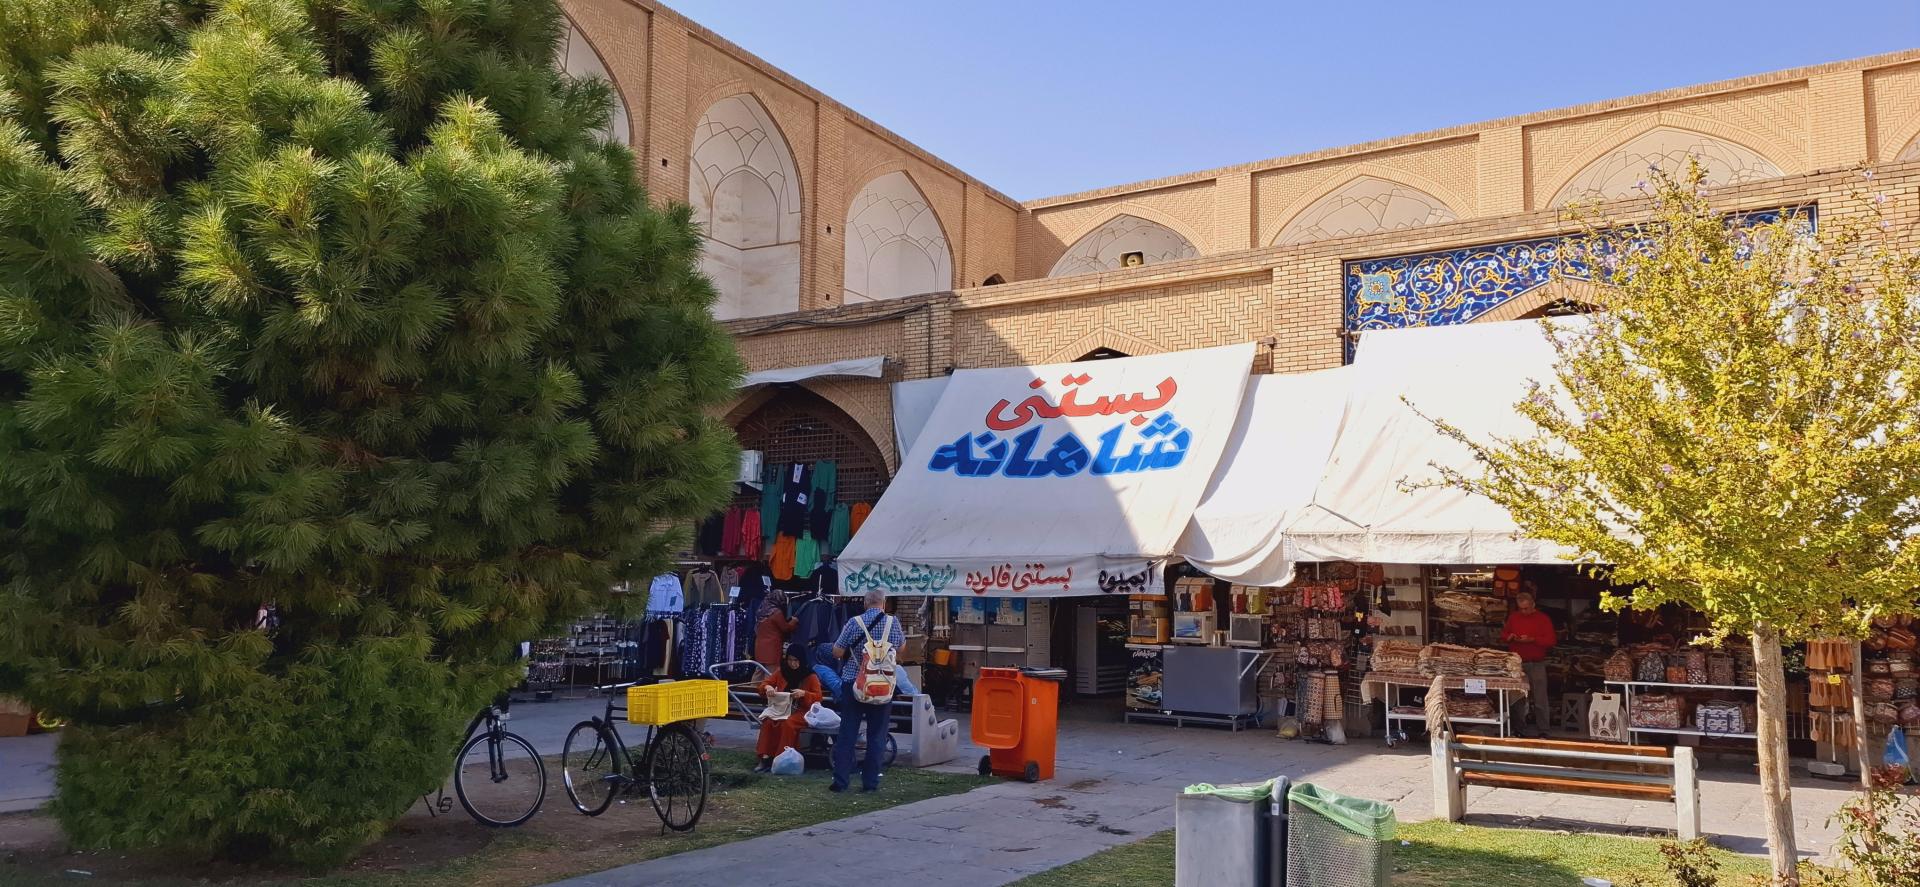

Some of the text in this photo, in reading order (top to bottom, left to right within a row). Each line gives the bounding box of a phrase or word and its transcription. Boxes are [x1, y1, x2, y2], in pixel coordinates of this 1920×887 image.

[986, 372, 1177, 431] بستنی
[928, 410, 1193, 479] شاهانه
[845, 563, 871, 592] گرم
[965, 563, 1011, 594] فالوده
[1012, 563, 1073, 592] بستنی
